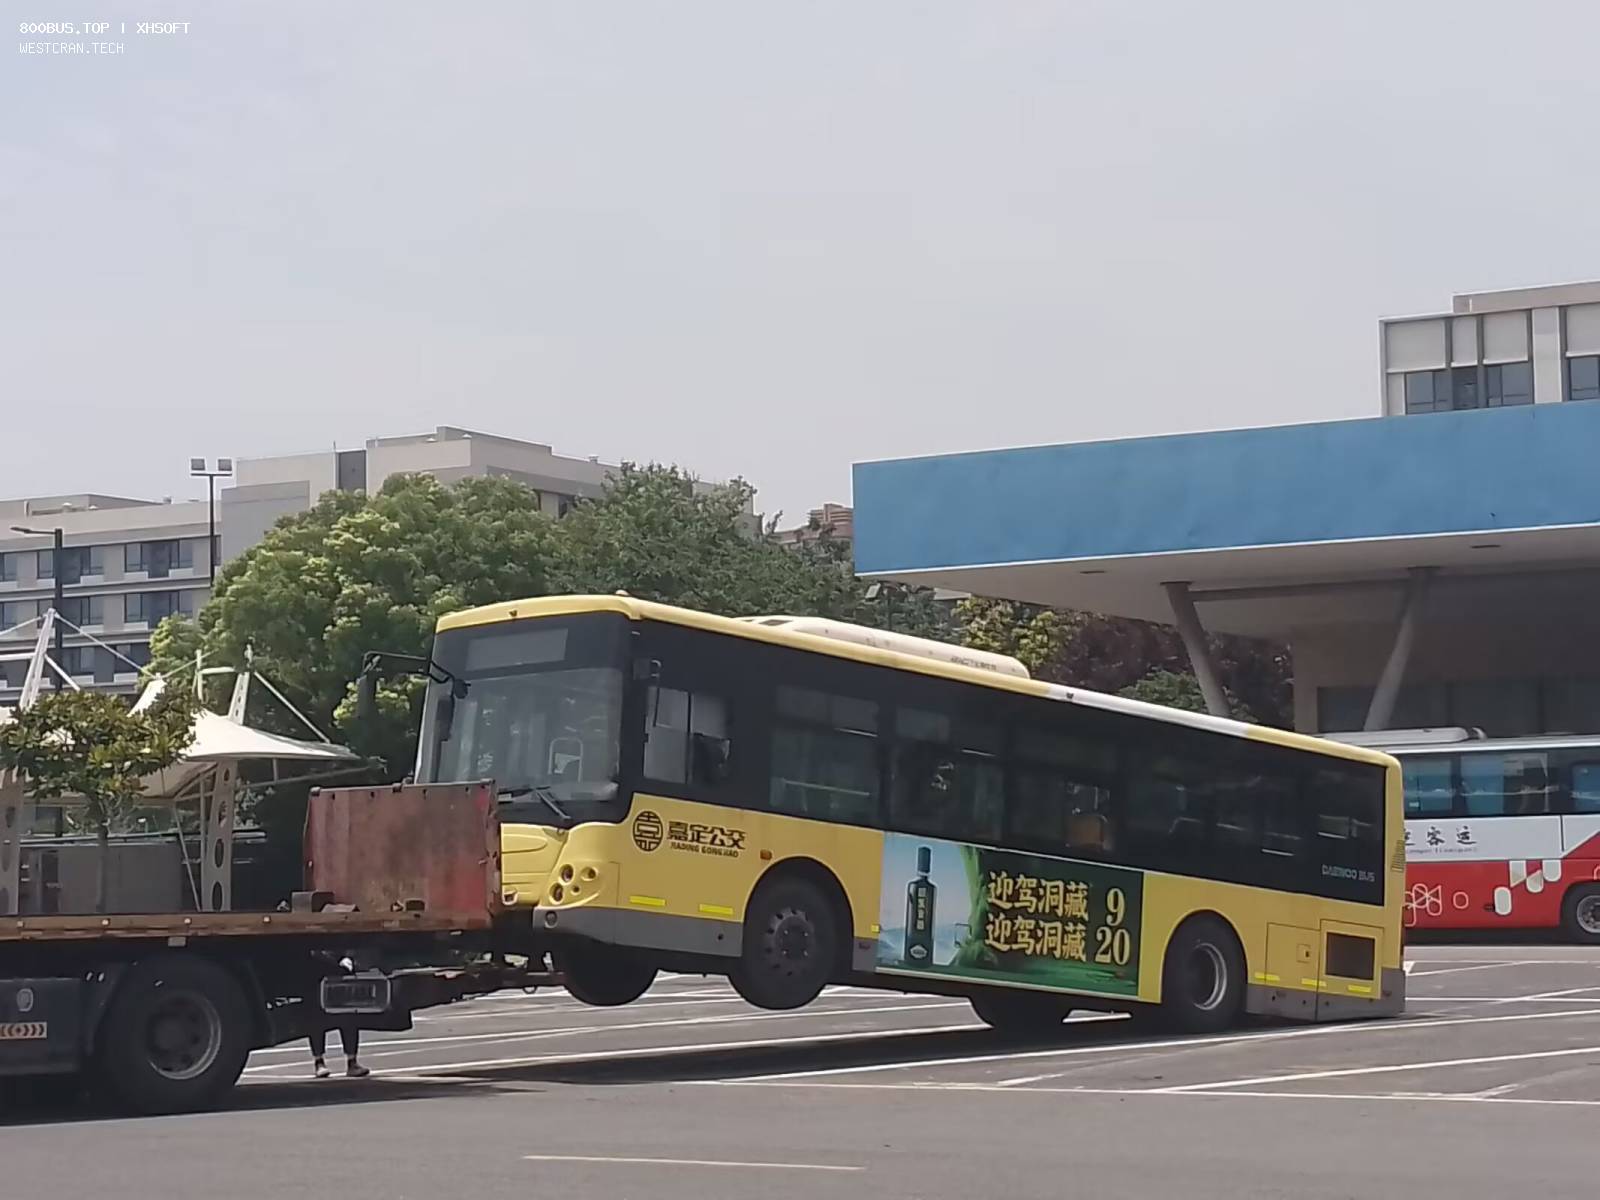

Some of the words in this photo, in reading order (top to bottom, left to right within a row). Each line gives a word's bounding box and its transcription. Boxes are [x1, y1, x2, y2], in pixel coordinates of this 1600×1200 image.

[666, 821, 746, 849] 嘉定公交
[1358, 870, 1375, 882] BUS
[987, 871, 1089, 921] 迎驾洞藏
[1106, 888, 1125, 926] 9
[984, 913, 1087, 962] 迎驾洞藏
[1096, 926, 1131, 966] 20
